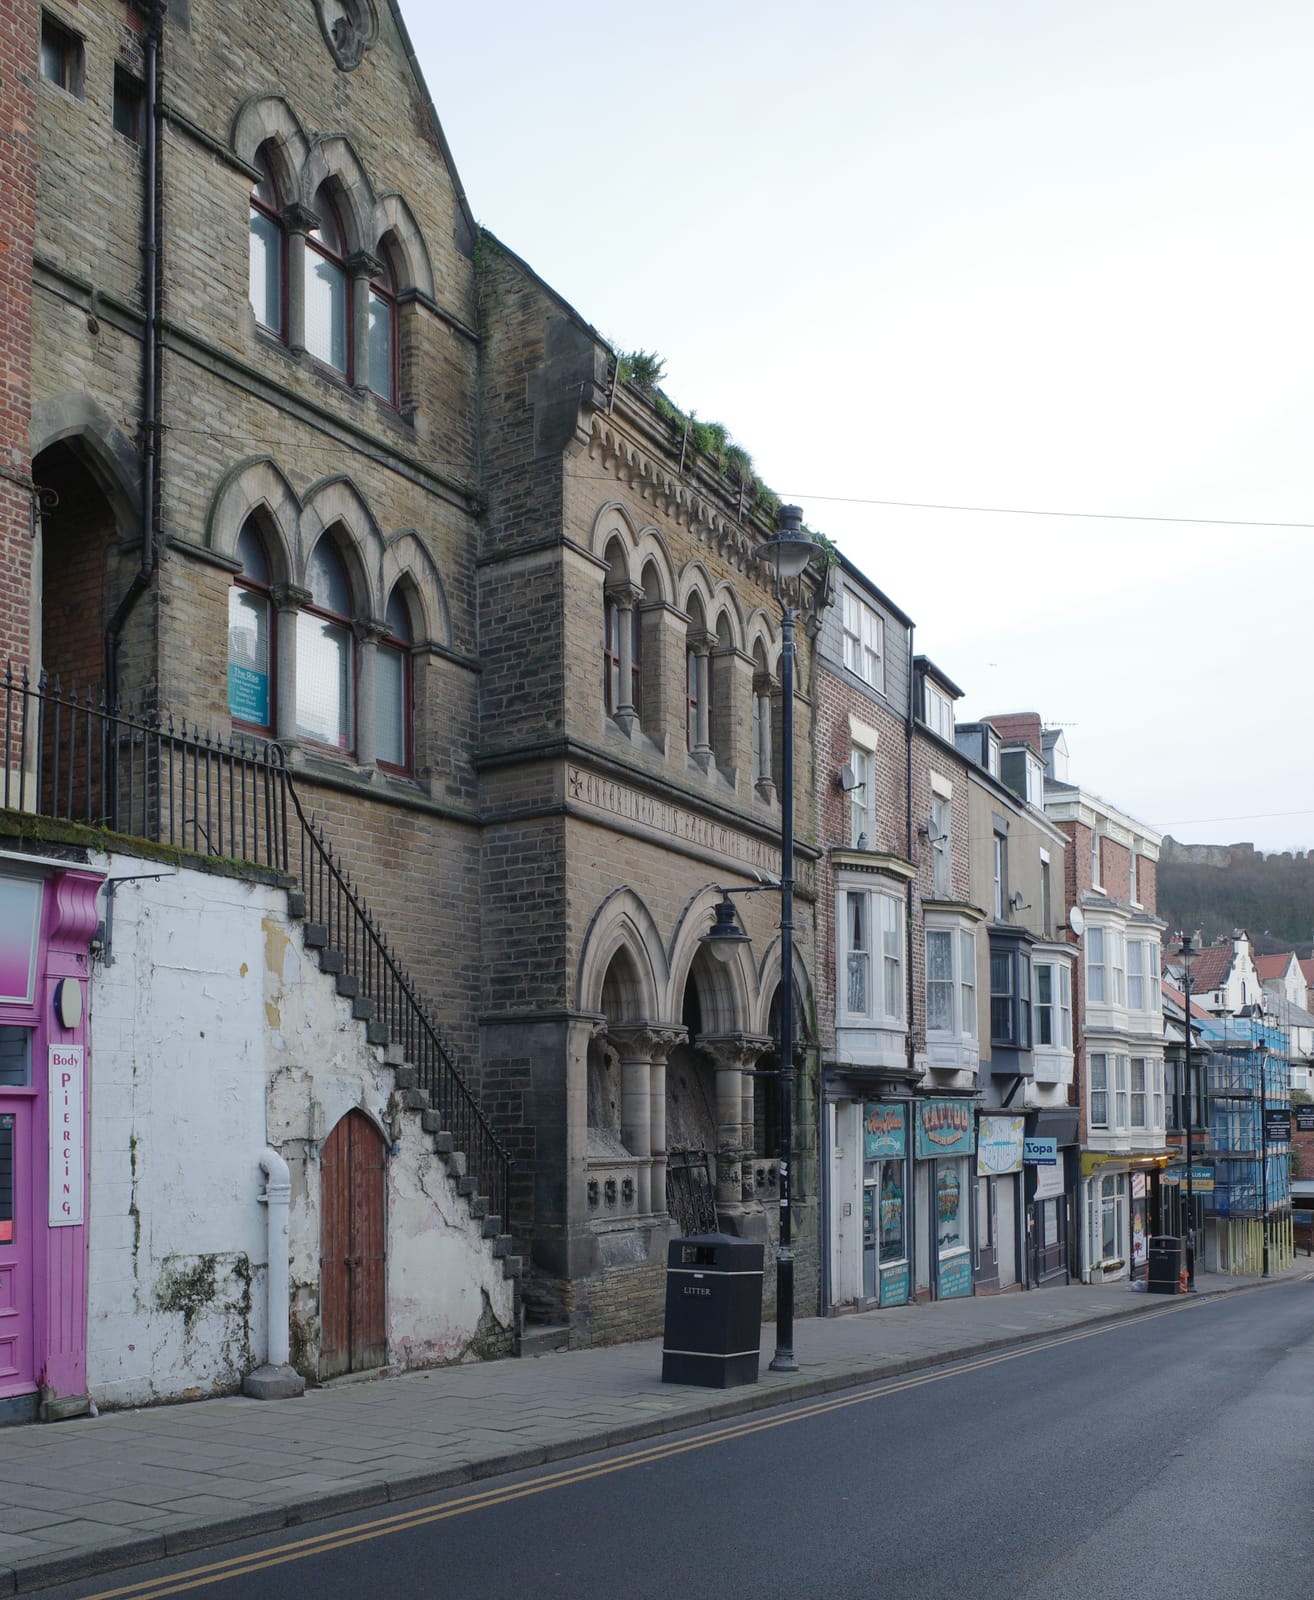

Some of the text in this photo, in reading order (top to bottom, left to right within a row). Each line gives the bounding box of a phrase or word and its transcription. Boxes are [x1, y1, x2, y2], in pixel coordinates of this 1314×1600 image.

[53, 1053, 79, 1068] Body
[922, 1103, 968, 1134] TATTOO
[1025, 1142, 1053, 1155] Yopa
[683, 1286, 712, 1296] LITTER
